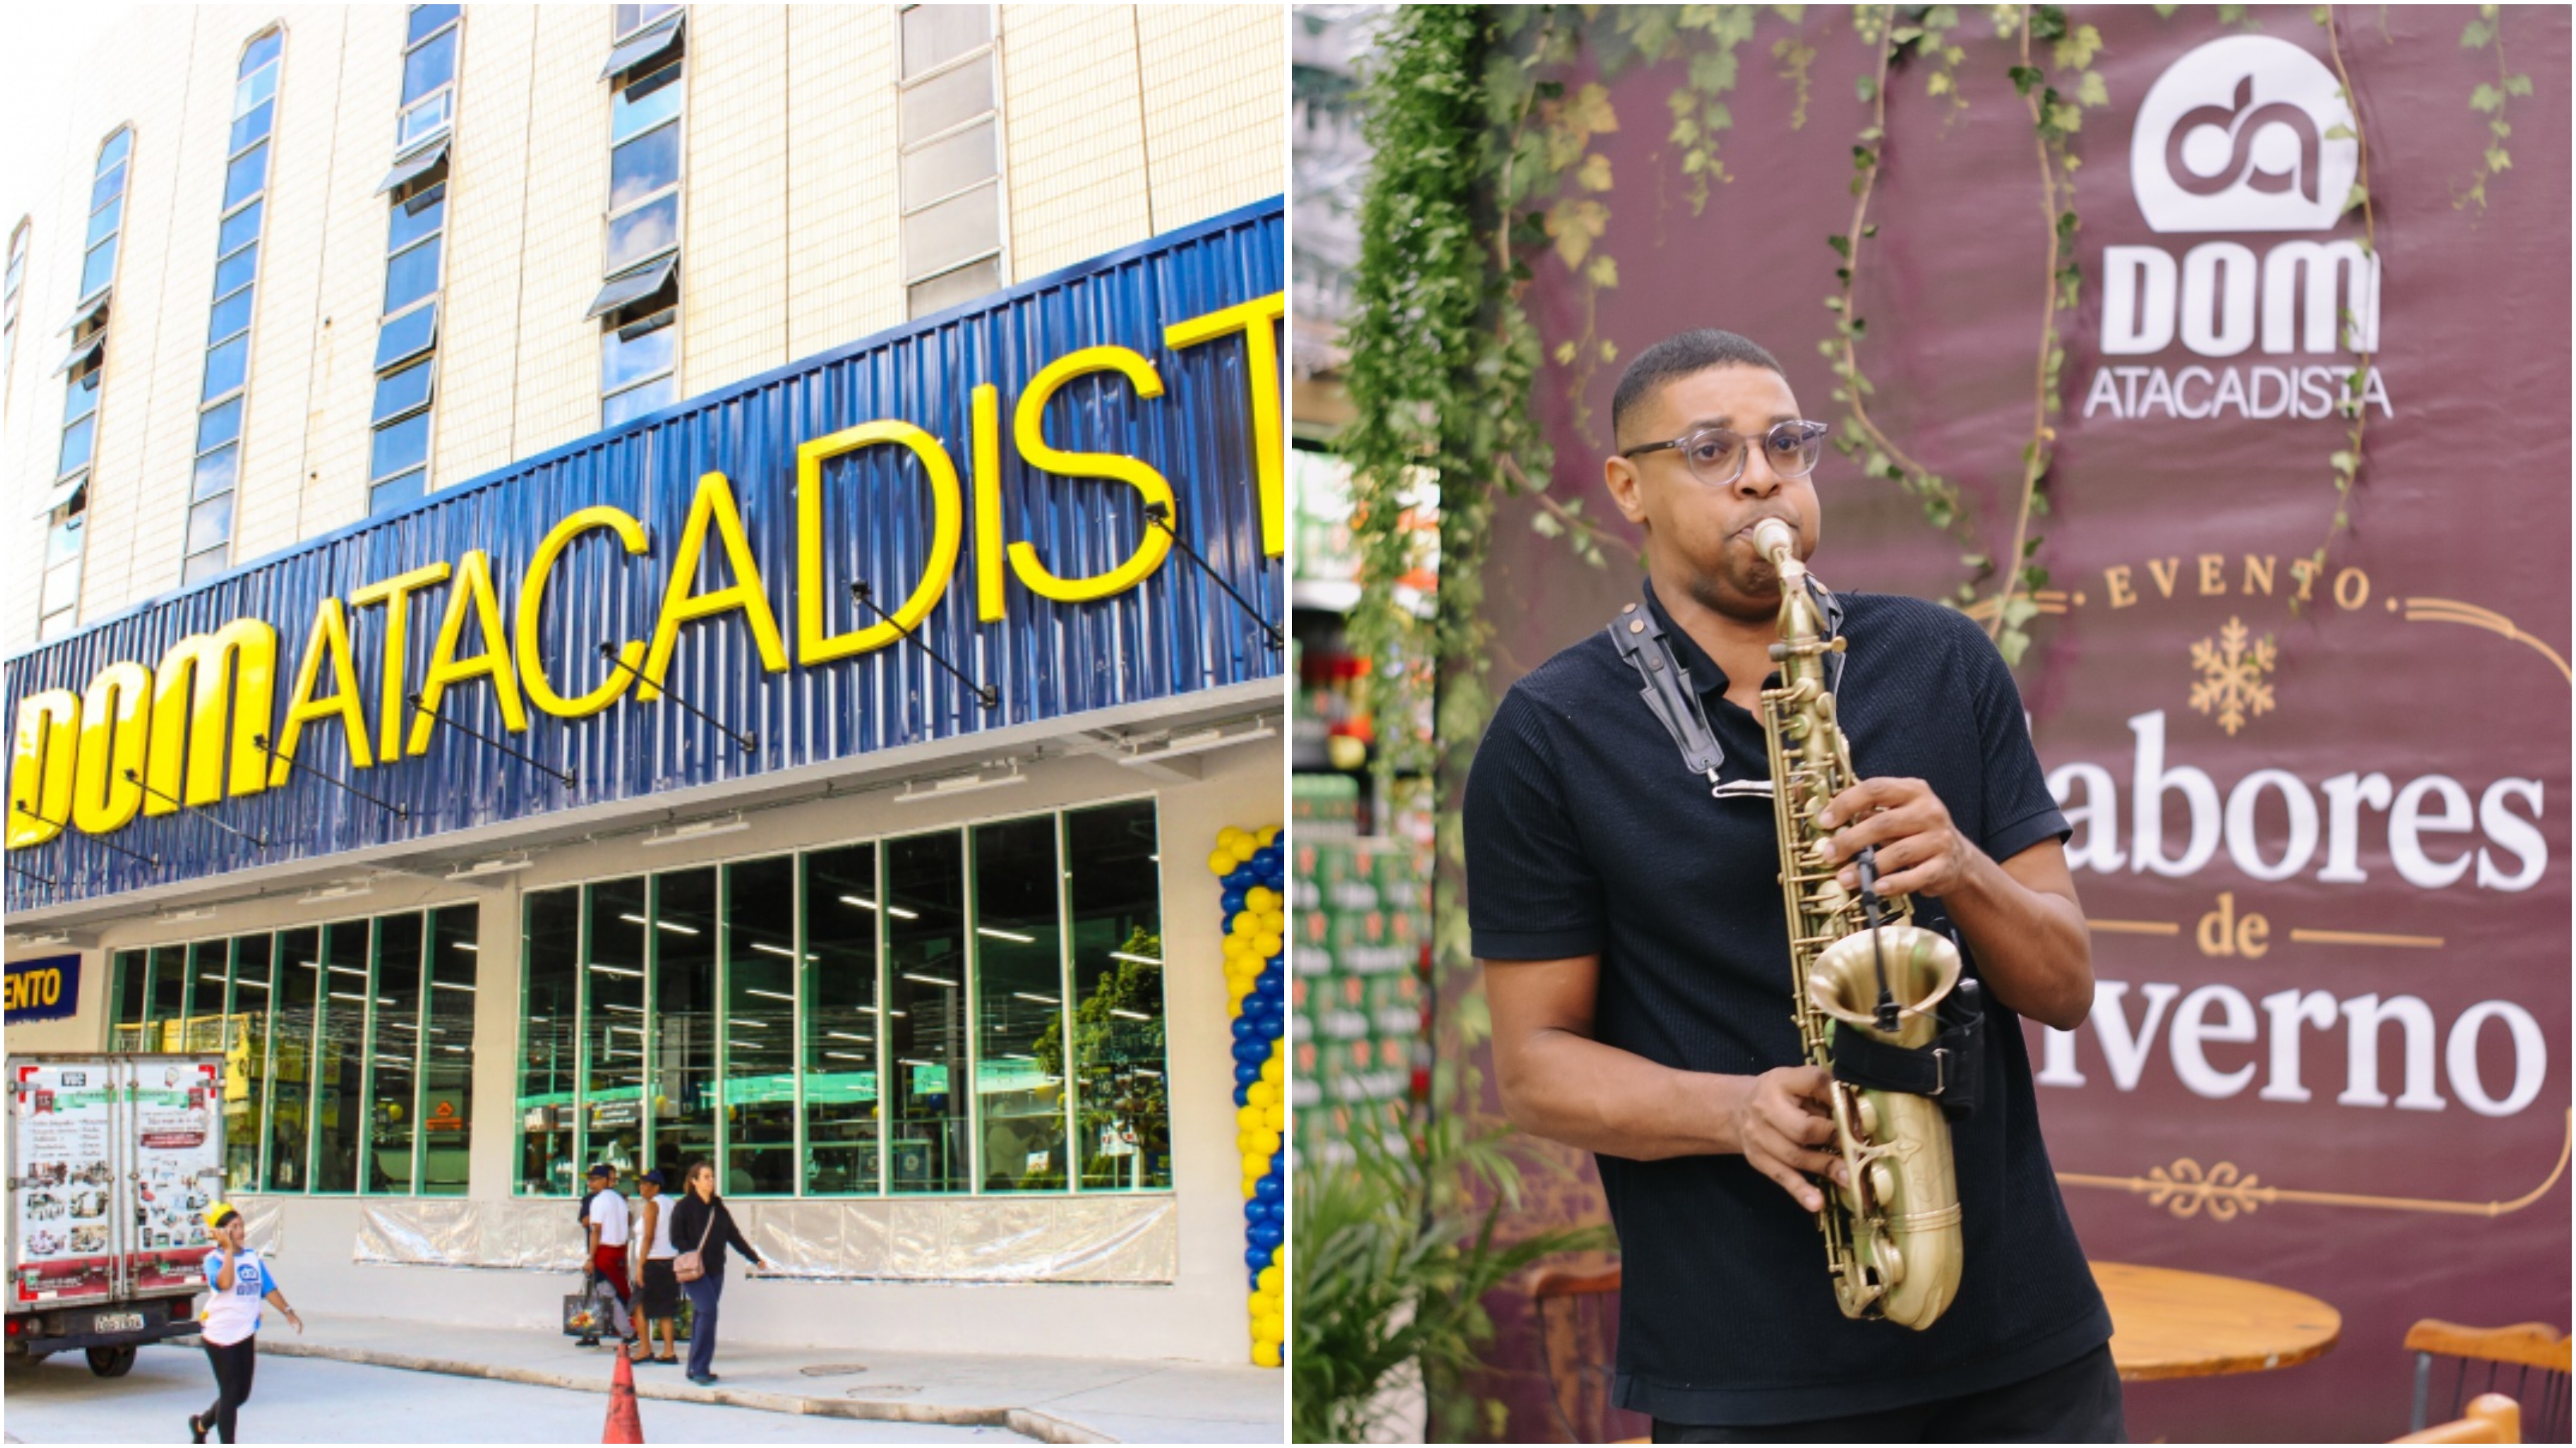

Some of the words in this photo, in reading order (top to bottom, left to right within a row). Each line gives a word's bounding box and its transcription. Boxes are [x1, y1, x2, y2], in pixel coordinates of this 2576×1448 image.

[2100, 239, 2381, 356] DOM
[6, 617, 277, 850] DOM
[269, 296, 1284, 787] ATACADIST
[2104, 554, 2370, 610] EVENTO
[2025, 708, 2548, 892] abores
[2196, 892, 2270, 959] de
[4, 967, 62, 1010] ENTO
